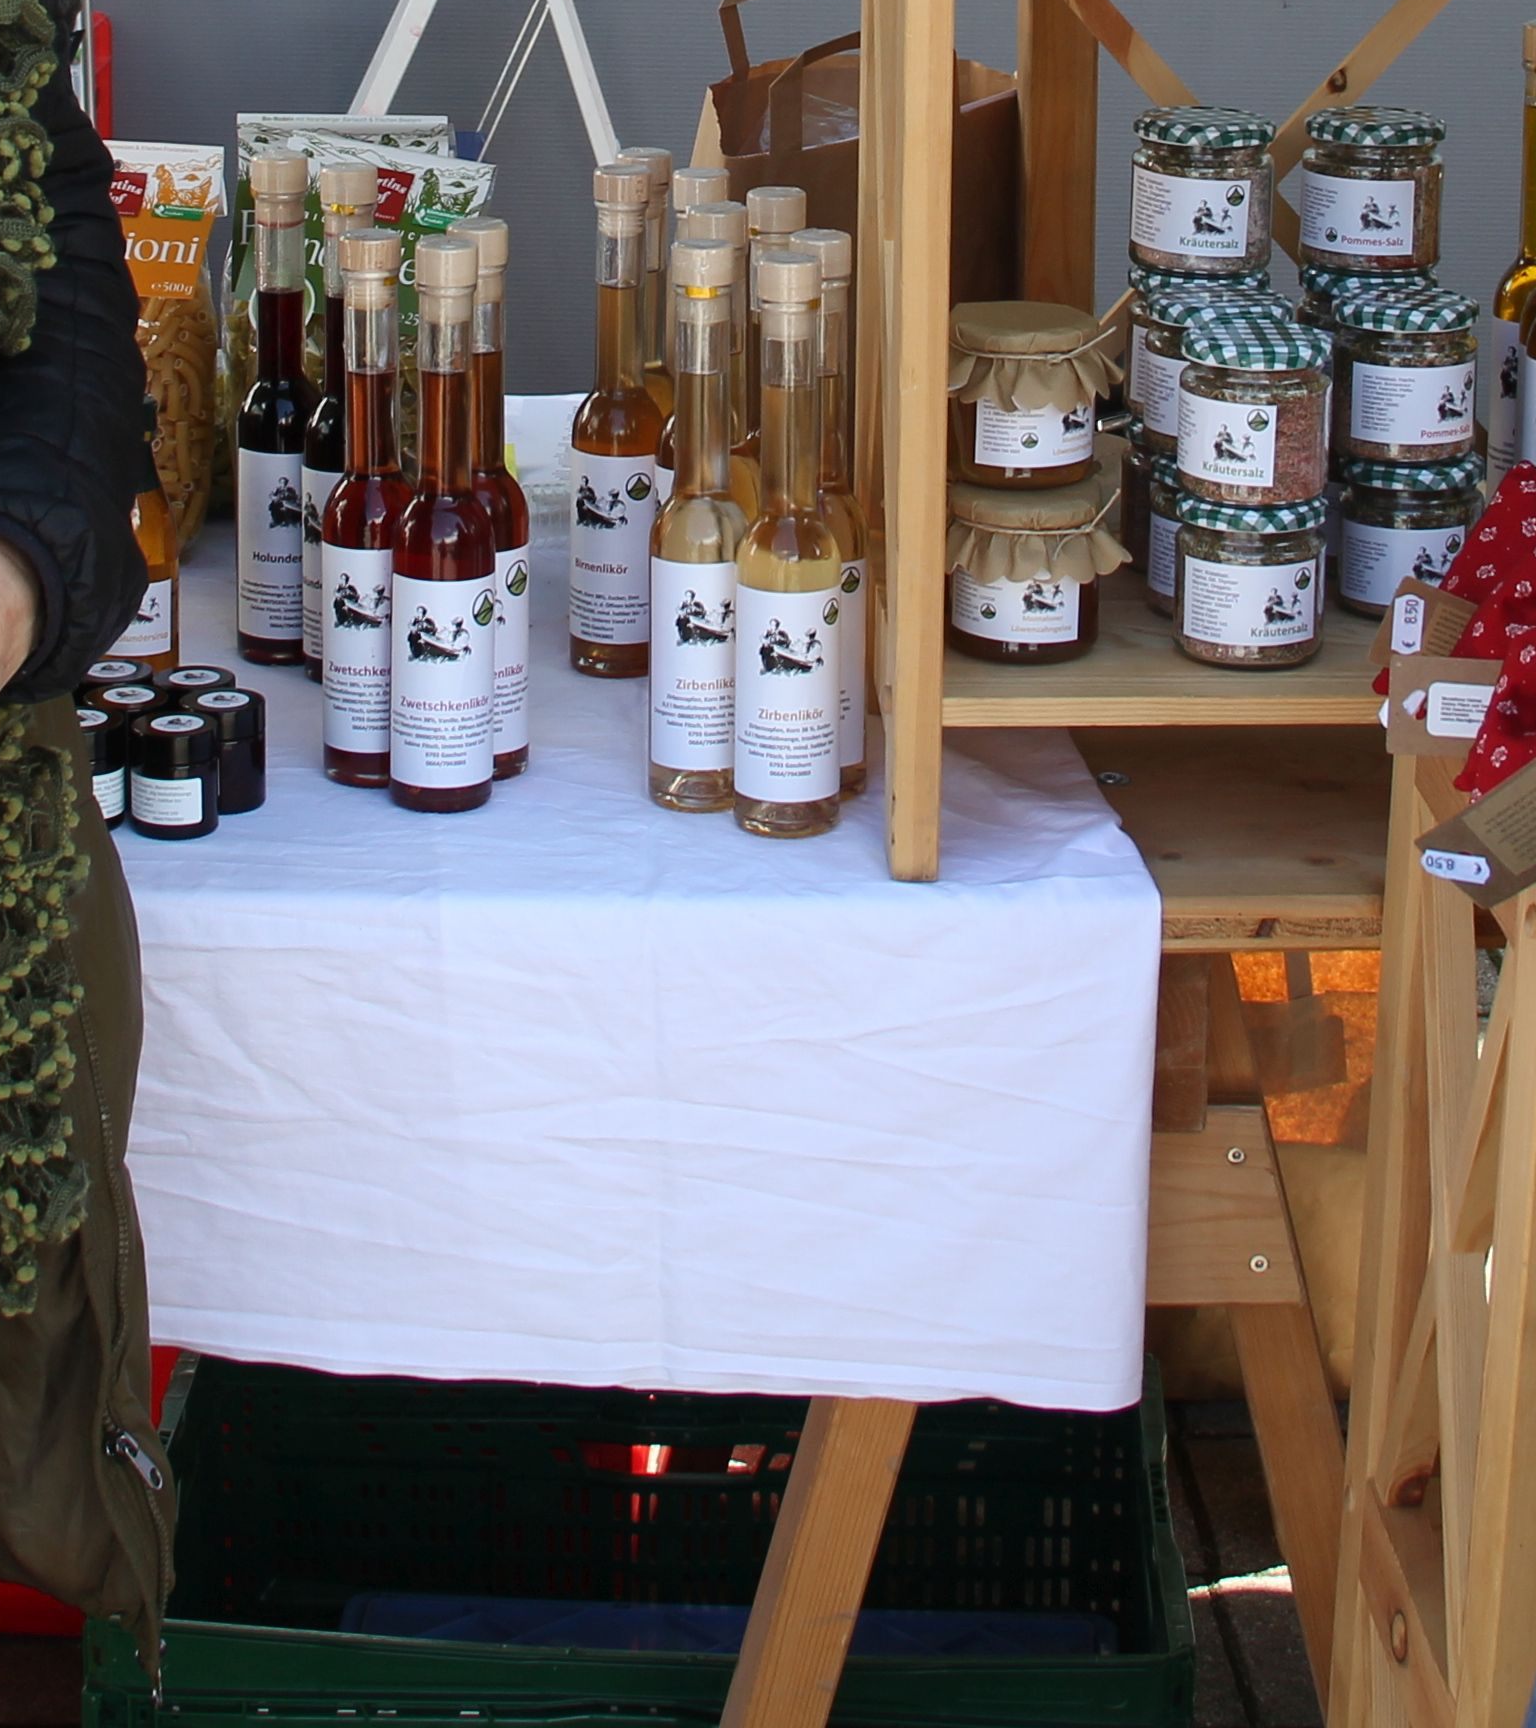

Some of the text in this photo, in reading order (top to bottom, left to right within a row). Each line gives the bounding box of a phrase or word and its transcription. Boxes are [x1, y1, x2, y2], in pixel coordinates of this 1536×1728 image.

[1179, 236, 1239, 249] Kräutersalz
[1341, 234, 1404, 247] Pommes-Salz
[1202, 460, 1265, 479] Kräutersalz
[575, 557, 629, 575] Birnenlikör
[1249, 623, 1309, 638] Kräutersalz
[676, 678, 736, 690] Zirbenlikö
[400, 695, 489, 712] Zwetschkenlikör
[758, 707, 824, 721] Zirbenlikör
